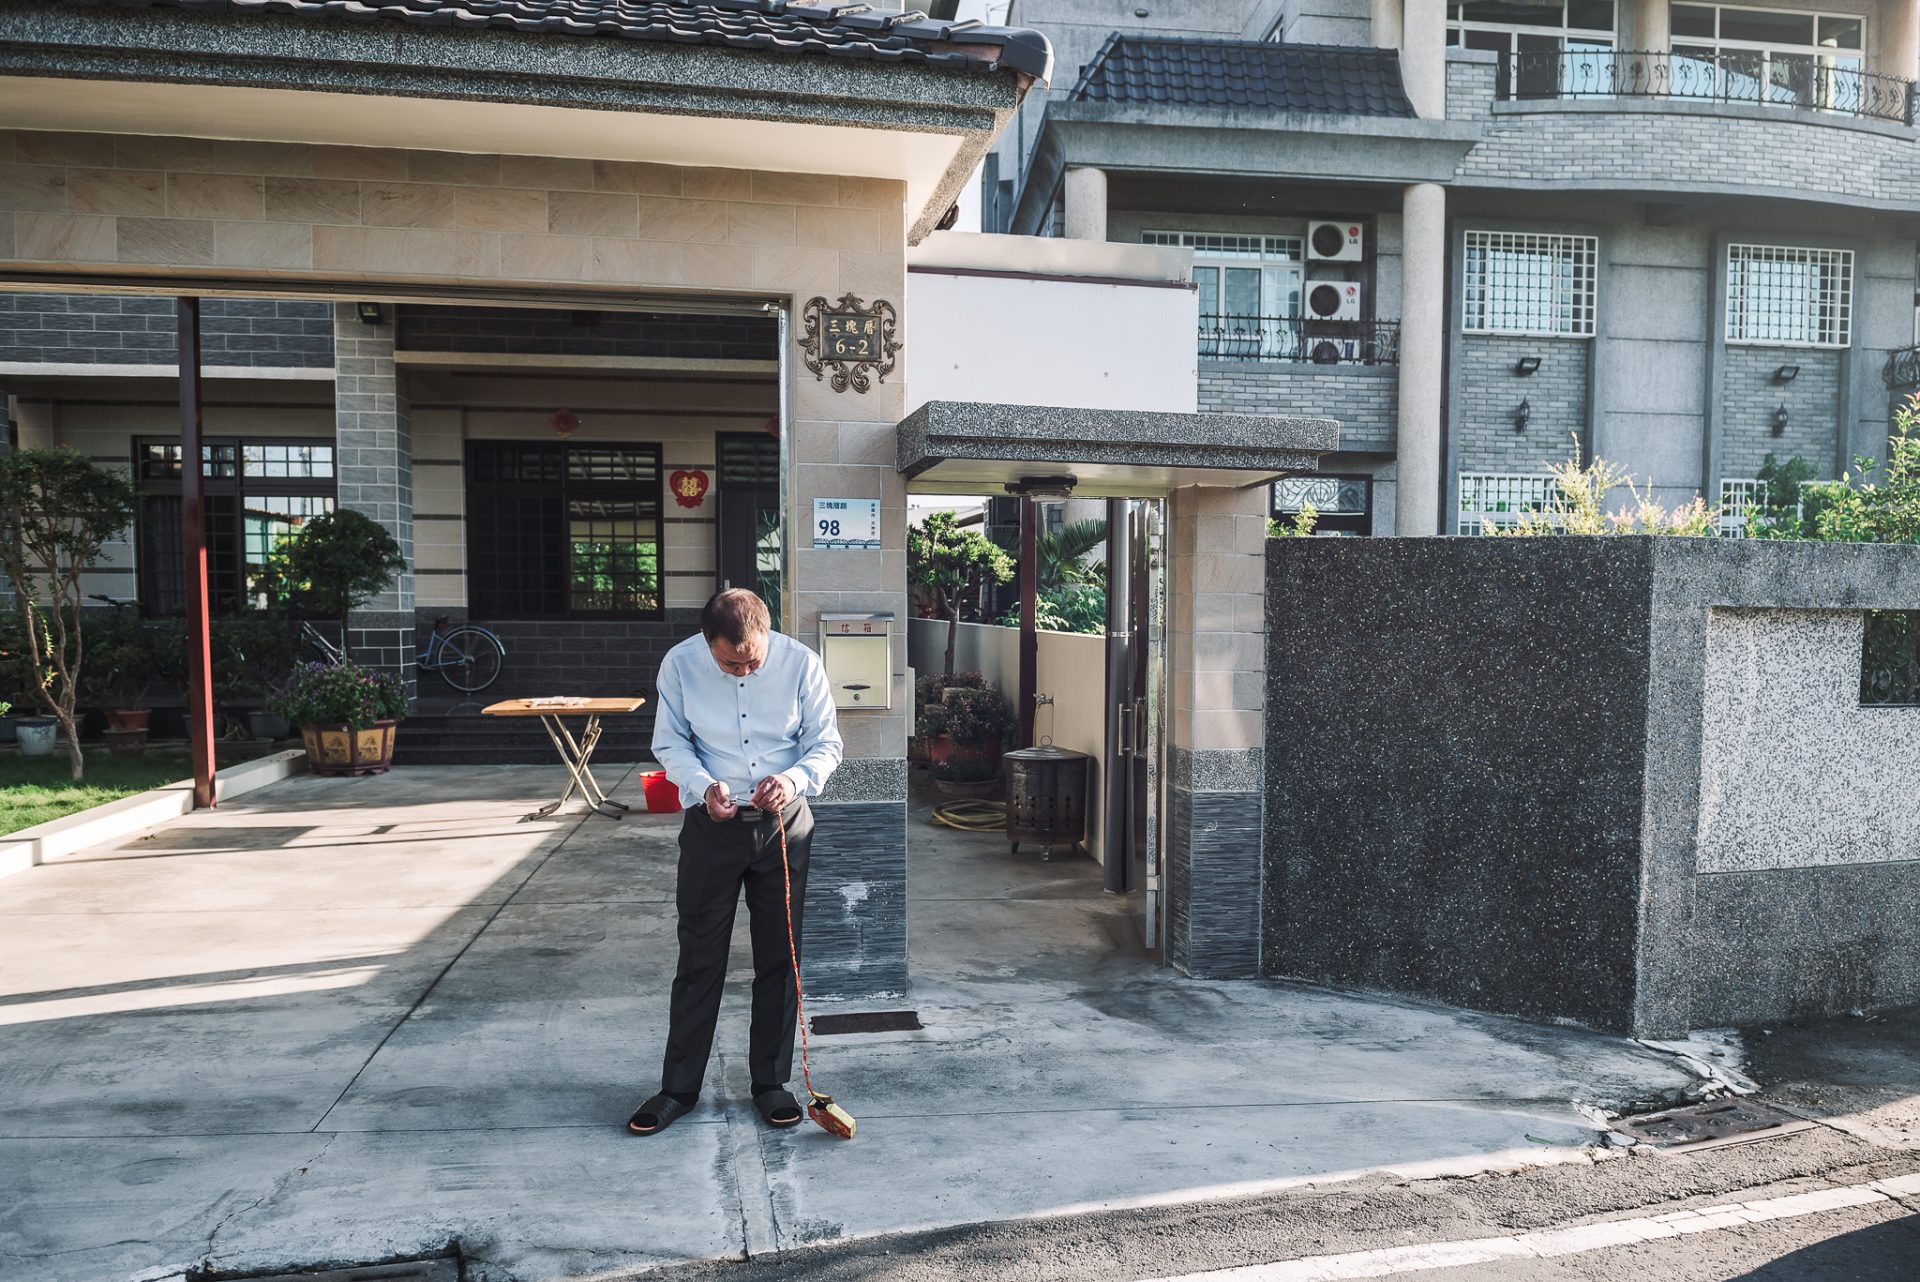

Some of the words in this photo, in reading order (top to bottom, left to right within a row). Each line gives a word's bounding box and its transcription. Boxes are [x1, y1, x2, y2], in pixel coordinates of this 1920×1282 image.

[835, 338, 869, 355] 6-2
[819, 519, 840, 536] 98
[841, 623, 872, 633] 信箱
